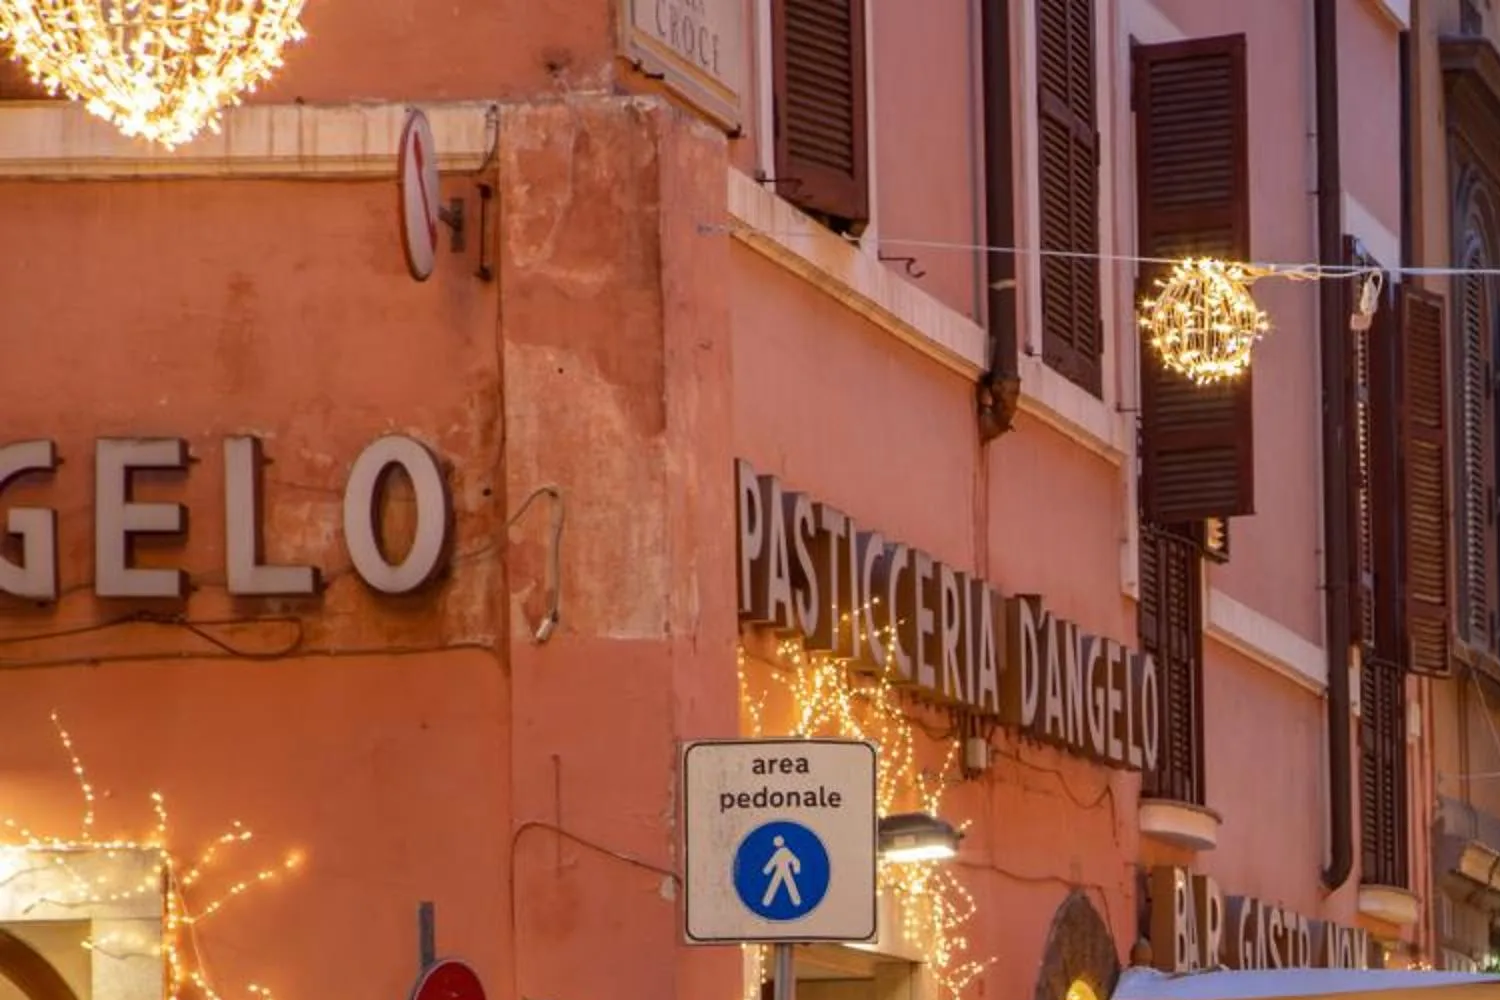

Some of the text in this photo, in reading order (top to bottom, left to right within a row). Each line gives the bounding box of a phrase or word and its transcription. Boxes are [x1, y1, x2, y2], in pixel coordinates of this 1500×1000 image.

[655, 0, 721, 76] CROCE
[735, 458, 1160, 771] PASTICCERIA D'ANGELO
[752, 757, 810, 775] area
[719, 786, 842, 814] pedonale
